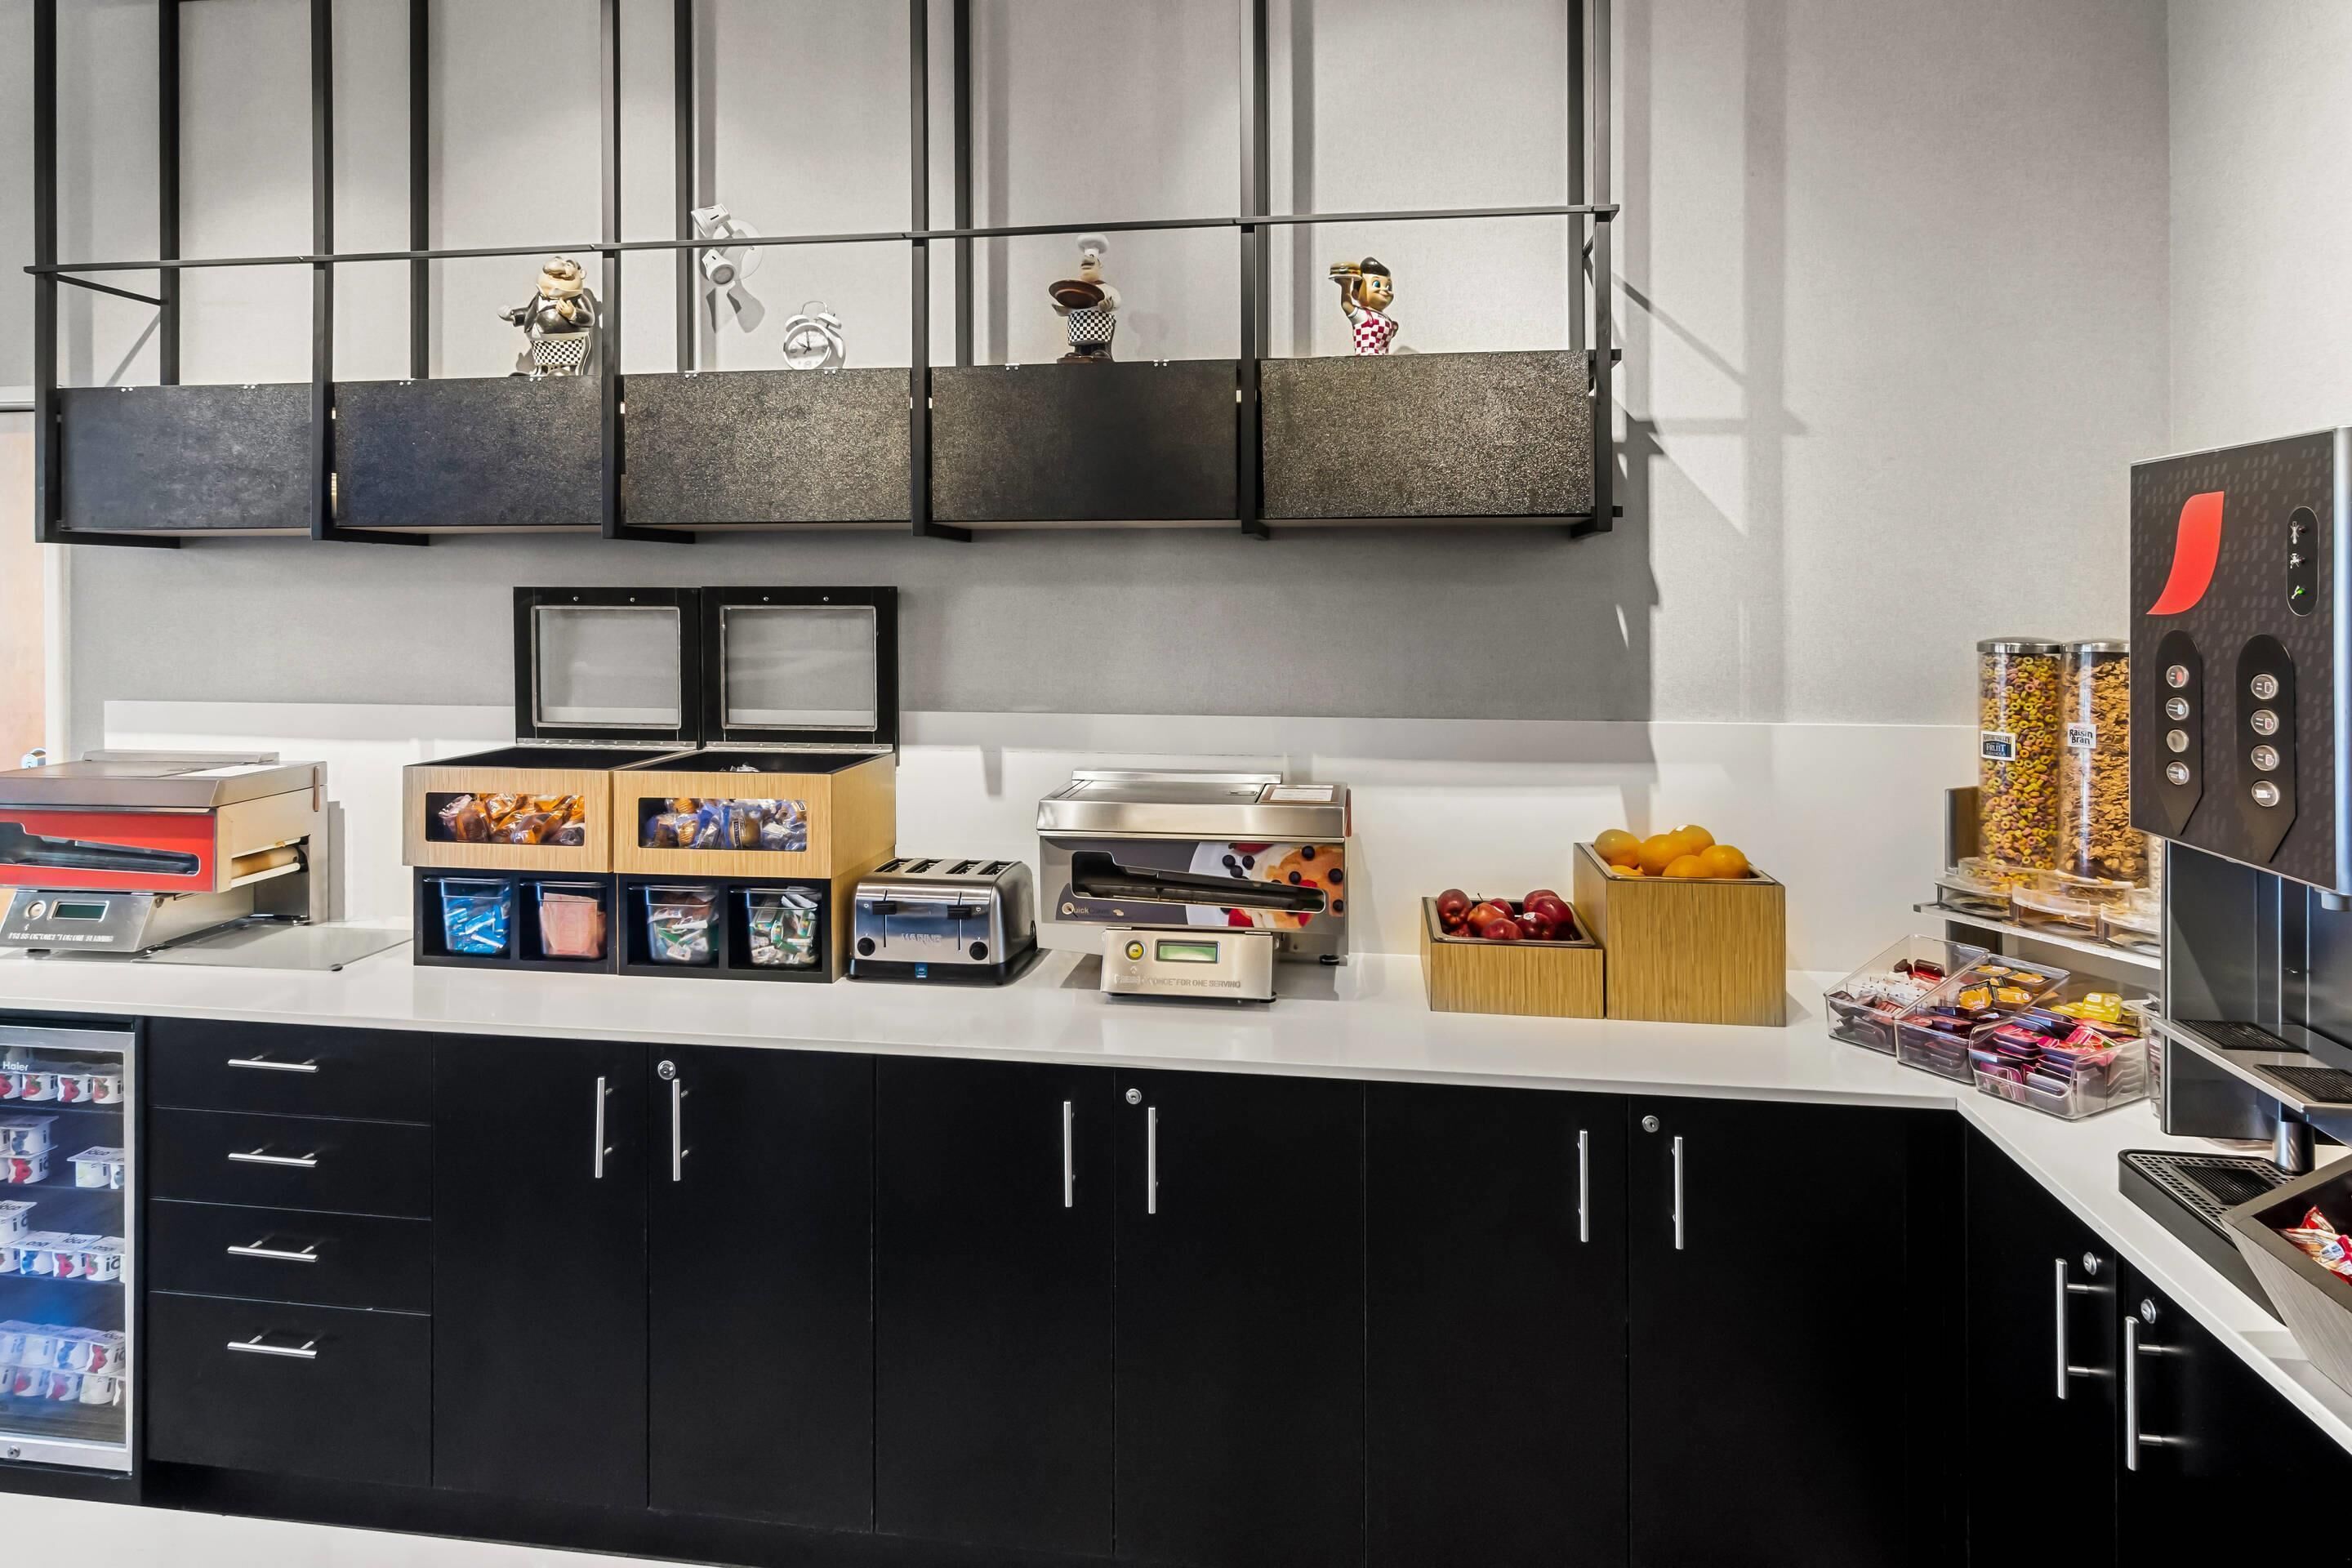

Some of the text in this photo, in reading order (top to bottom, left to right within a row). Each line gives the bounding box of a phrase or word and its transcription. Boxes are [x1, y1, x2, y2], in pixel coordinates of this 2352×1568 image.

[2069, 728, 2093, 738] Raisin
[2071, 737, 2091, 745] Bran
[1192, 979, 1208, 987] ONE
[1209, 980, 1241, 988] SERVING
[2, 1062, 29, 1071] Haier
